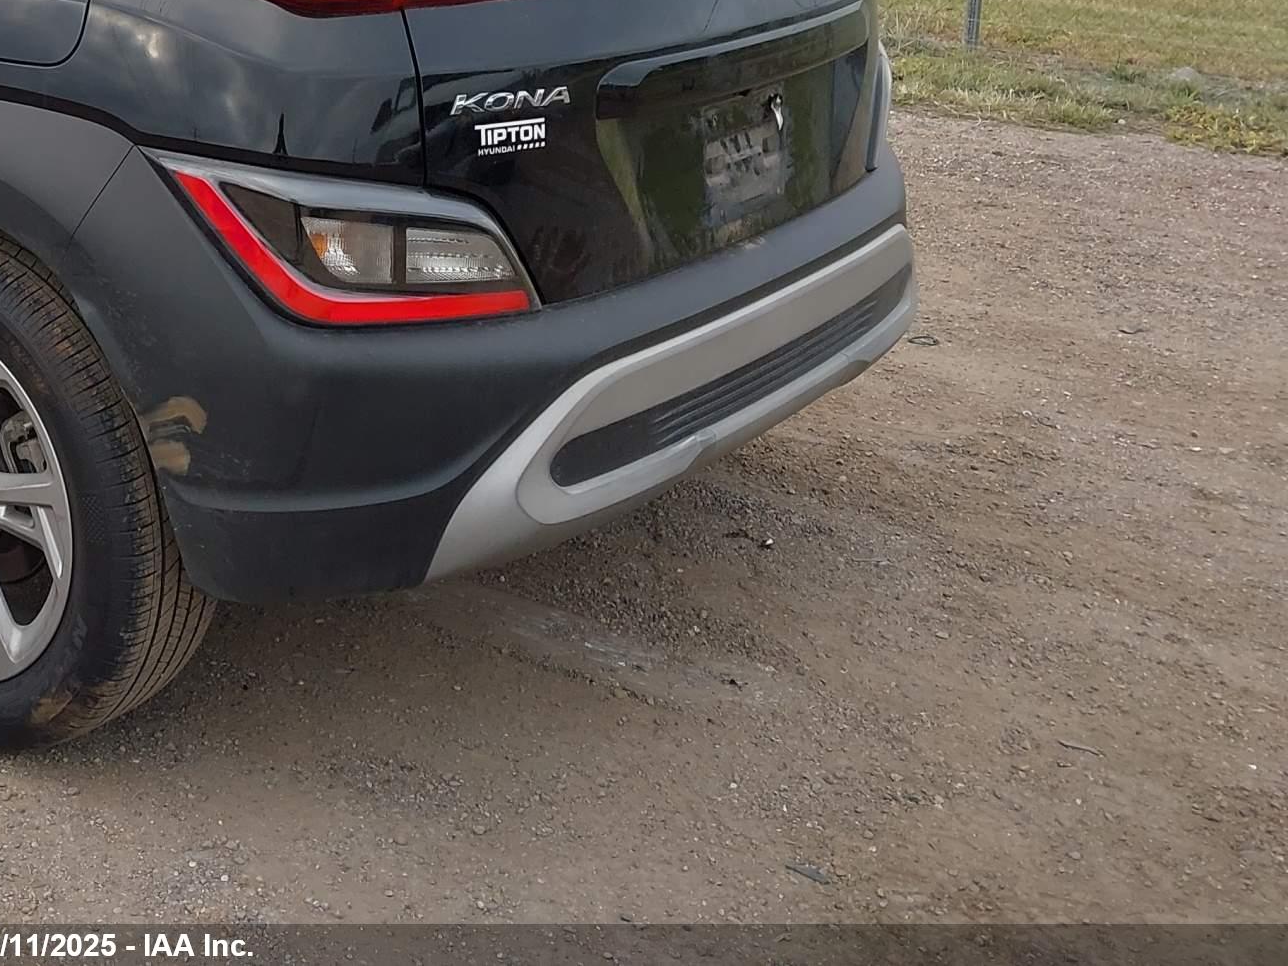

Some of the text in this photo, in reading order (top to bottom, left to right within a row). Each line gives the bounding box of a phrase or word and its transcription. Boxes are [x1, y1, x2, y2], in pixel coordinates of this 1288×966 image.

[449, 86, 571, 116] KONA
[474, 117, 546, 147] TIPTON
[477, 144, 516, 157] HYUNDAI
